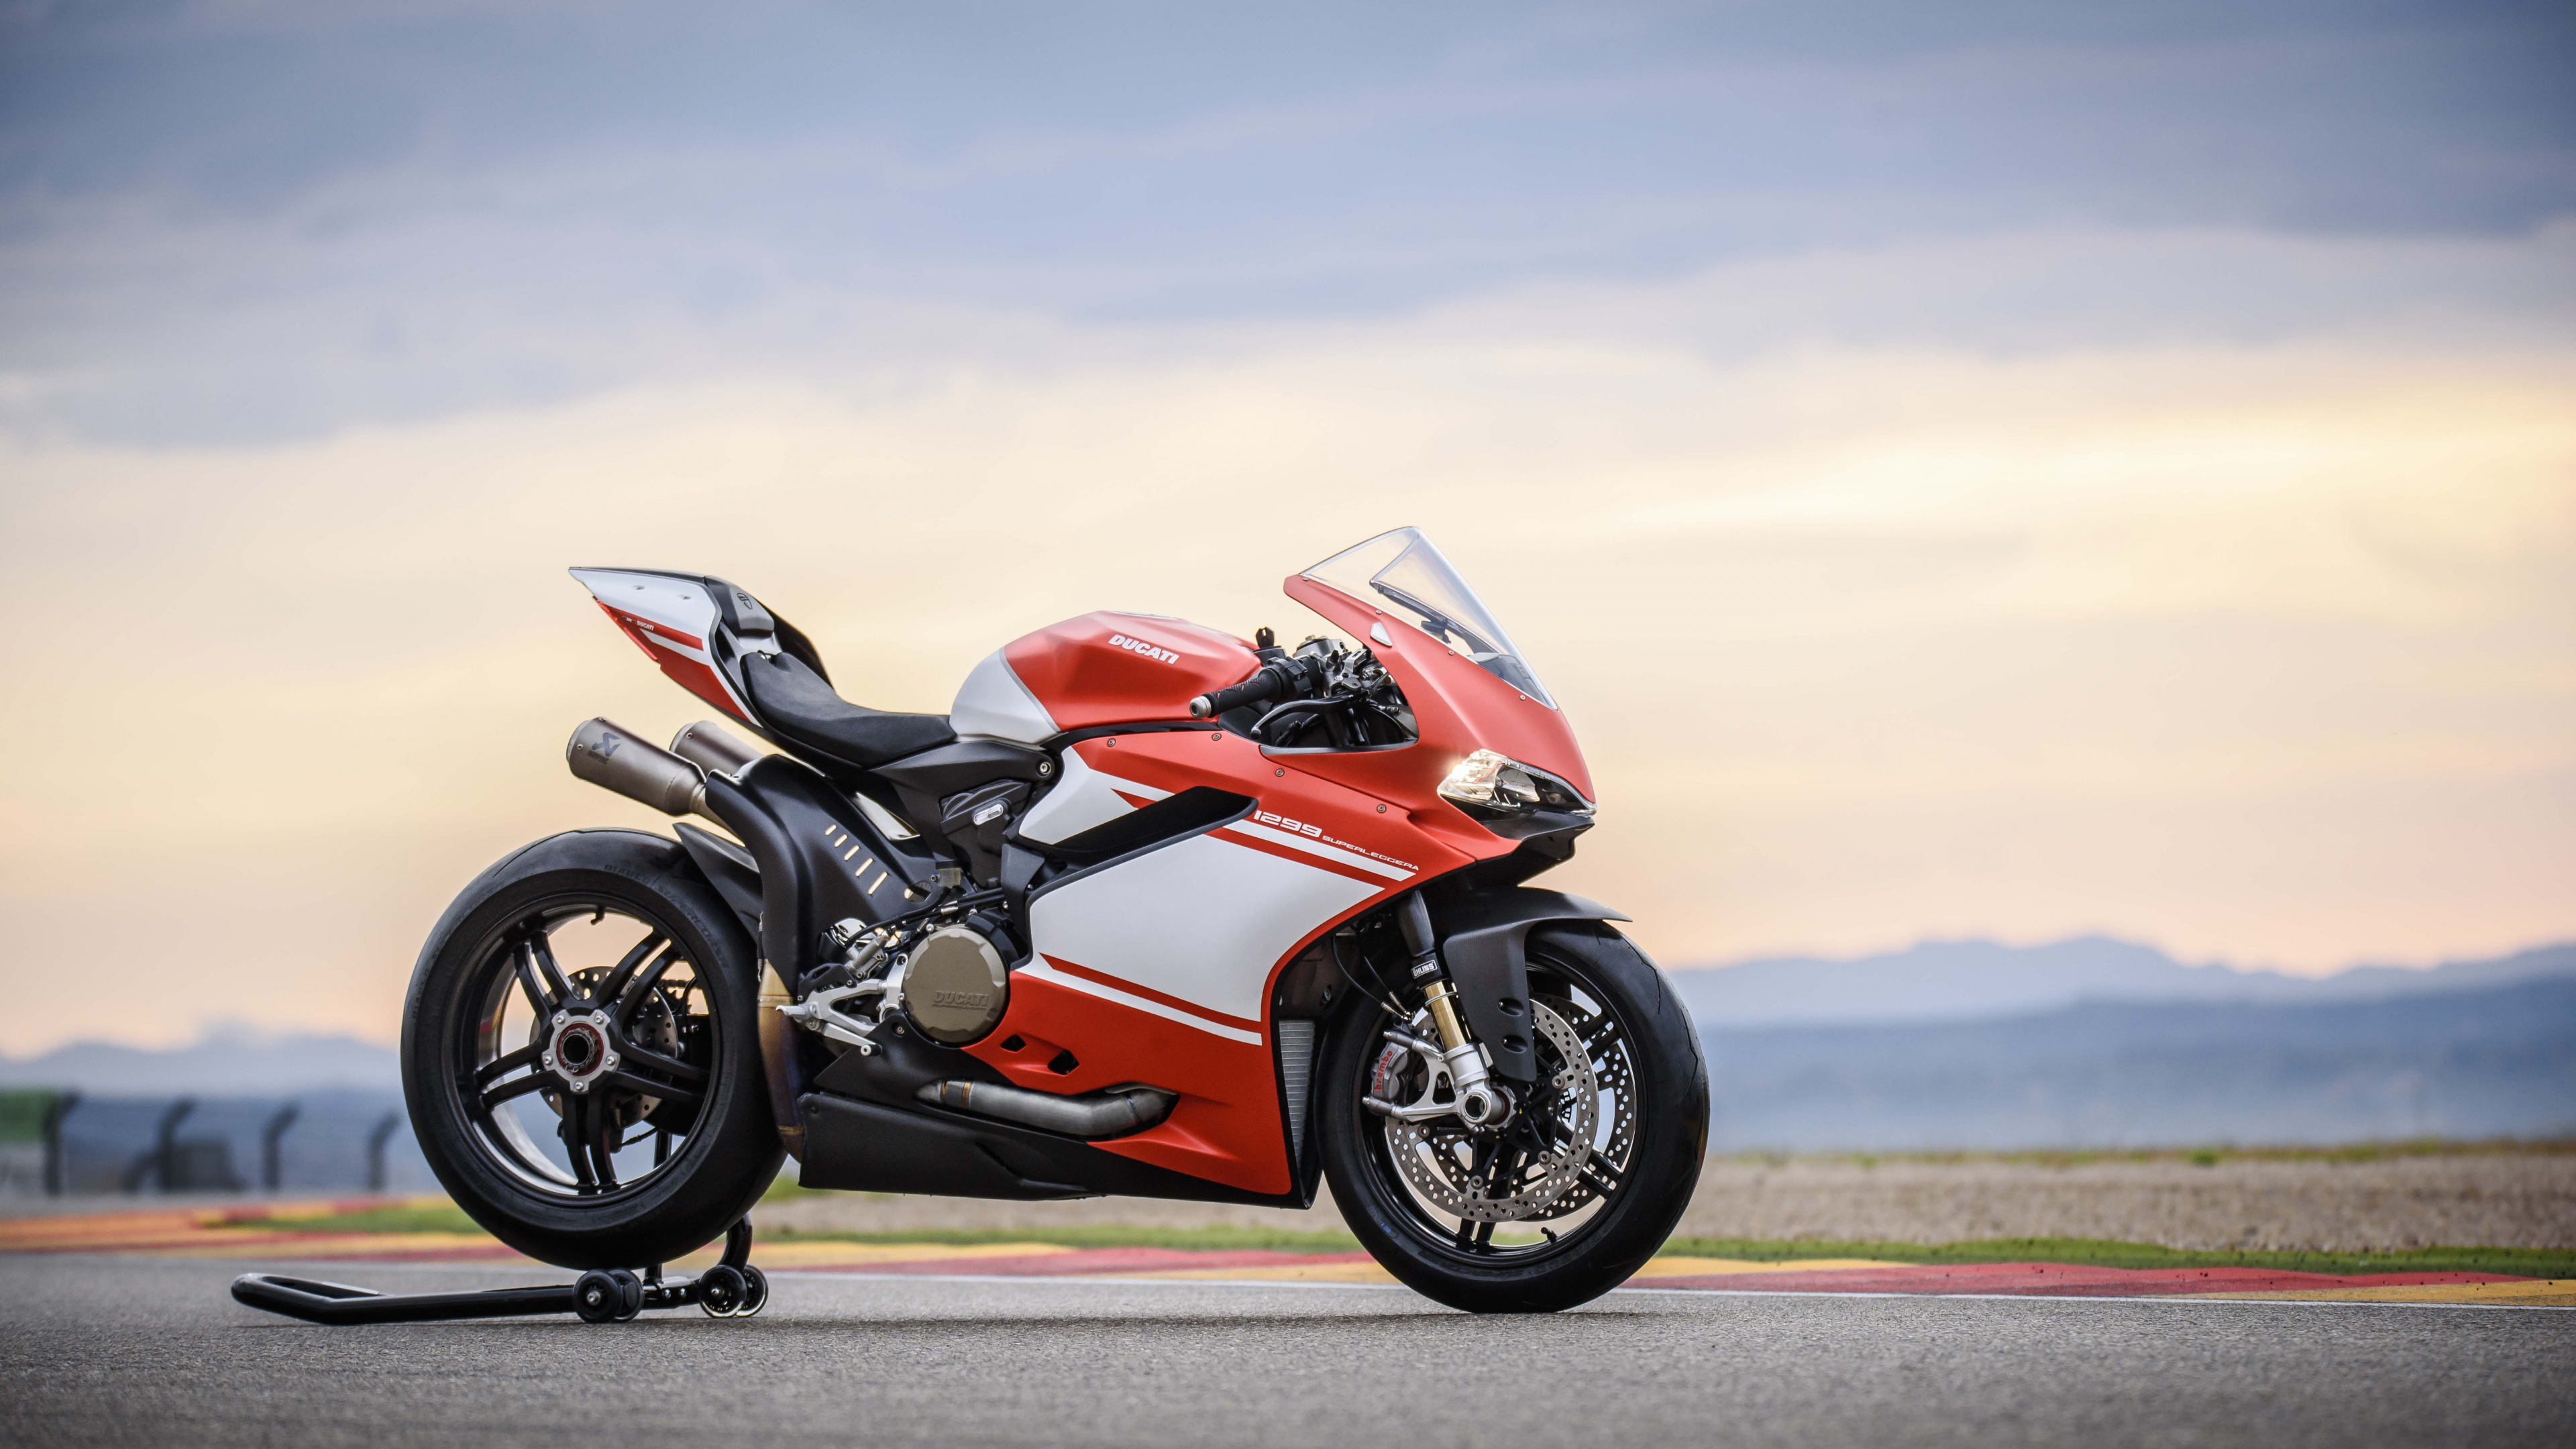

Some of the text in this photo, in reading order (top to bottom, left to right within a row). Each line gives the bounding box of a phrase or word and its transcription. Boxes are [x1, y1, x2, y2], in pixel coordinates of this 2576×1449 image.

[637, 620, 655, 631] DUCATI
[1108, 634, 1180, 665] DUCATI
[1253, 810, 1419, 871] 1299 SUPERLEGGERA
[1412, 961, 1434, 977] ÖHLINS
[933, 990, 990, 1006] DUCATI
[1374, 1051, 1393, 1091] brembo
